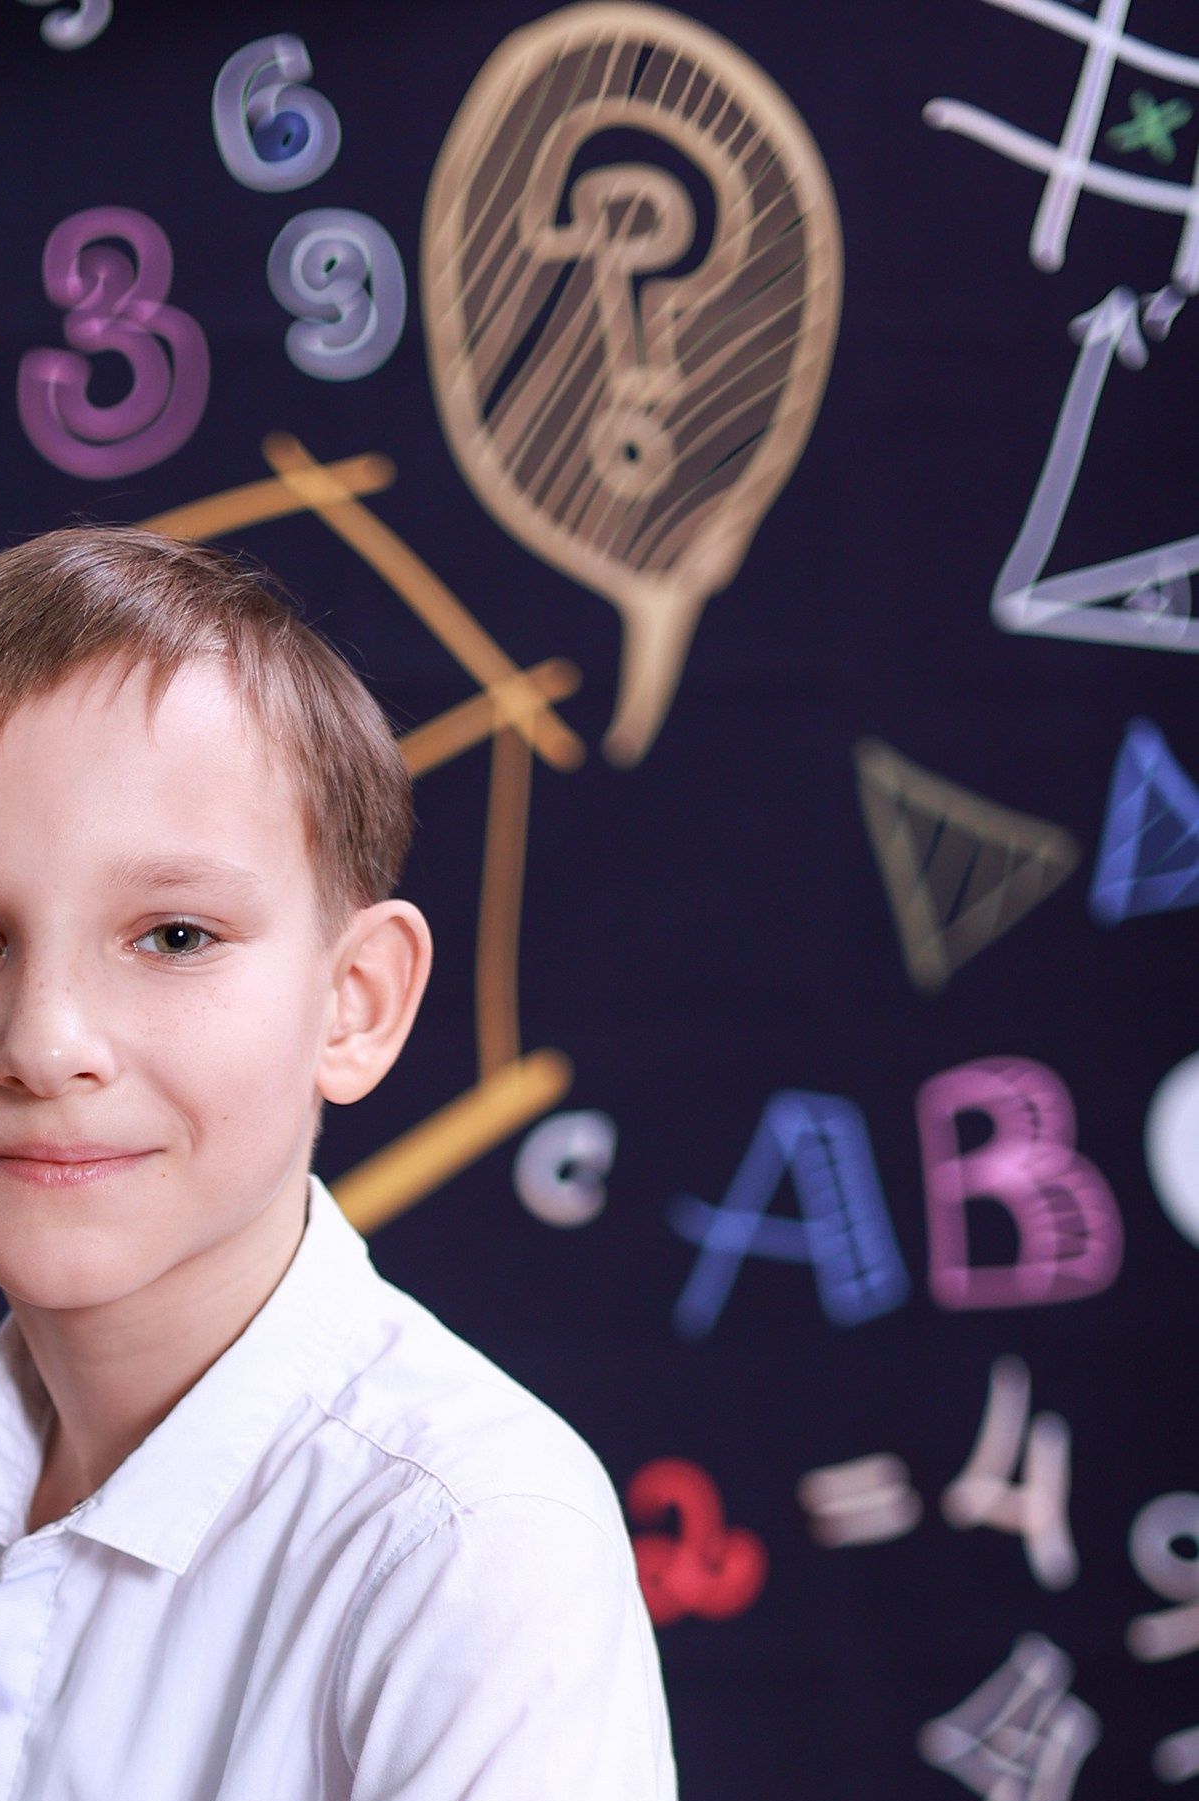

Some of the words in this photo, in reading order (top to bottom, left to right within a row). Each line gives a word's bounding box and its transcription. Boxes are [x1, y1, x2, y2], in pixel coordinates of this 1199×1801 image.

[212, 32, 342, 193] 6
[17, 205, 212, 481] 3
[266, 207, 408, 383] 9
